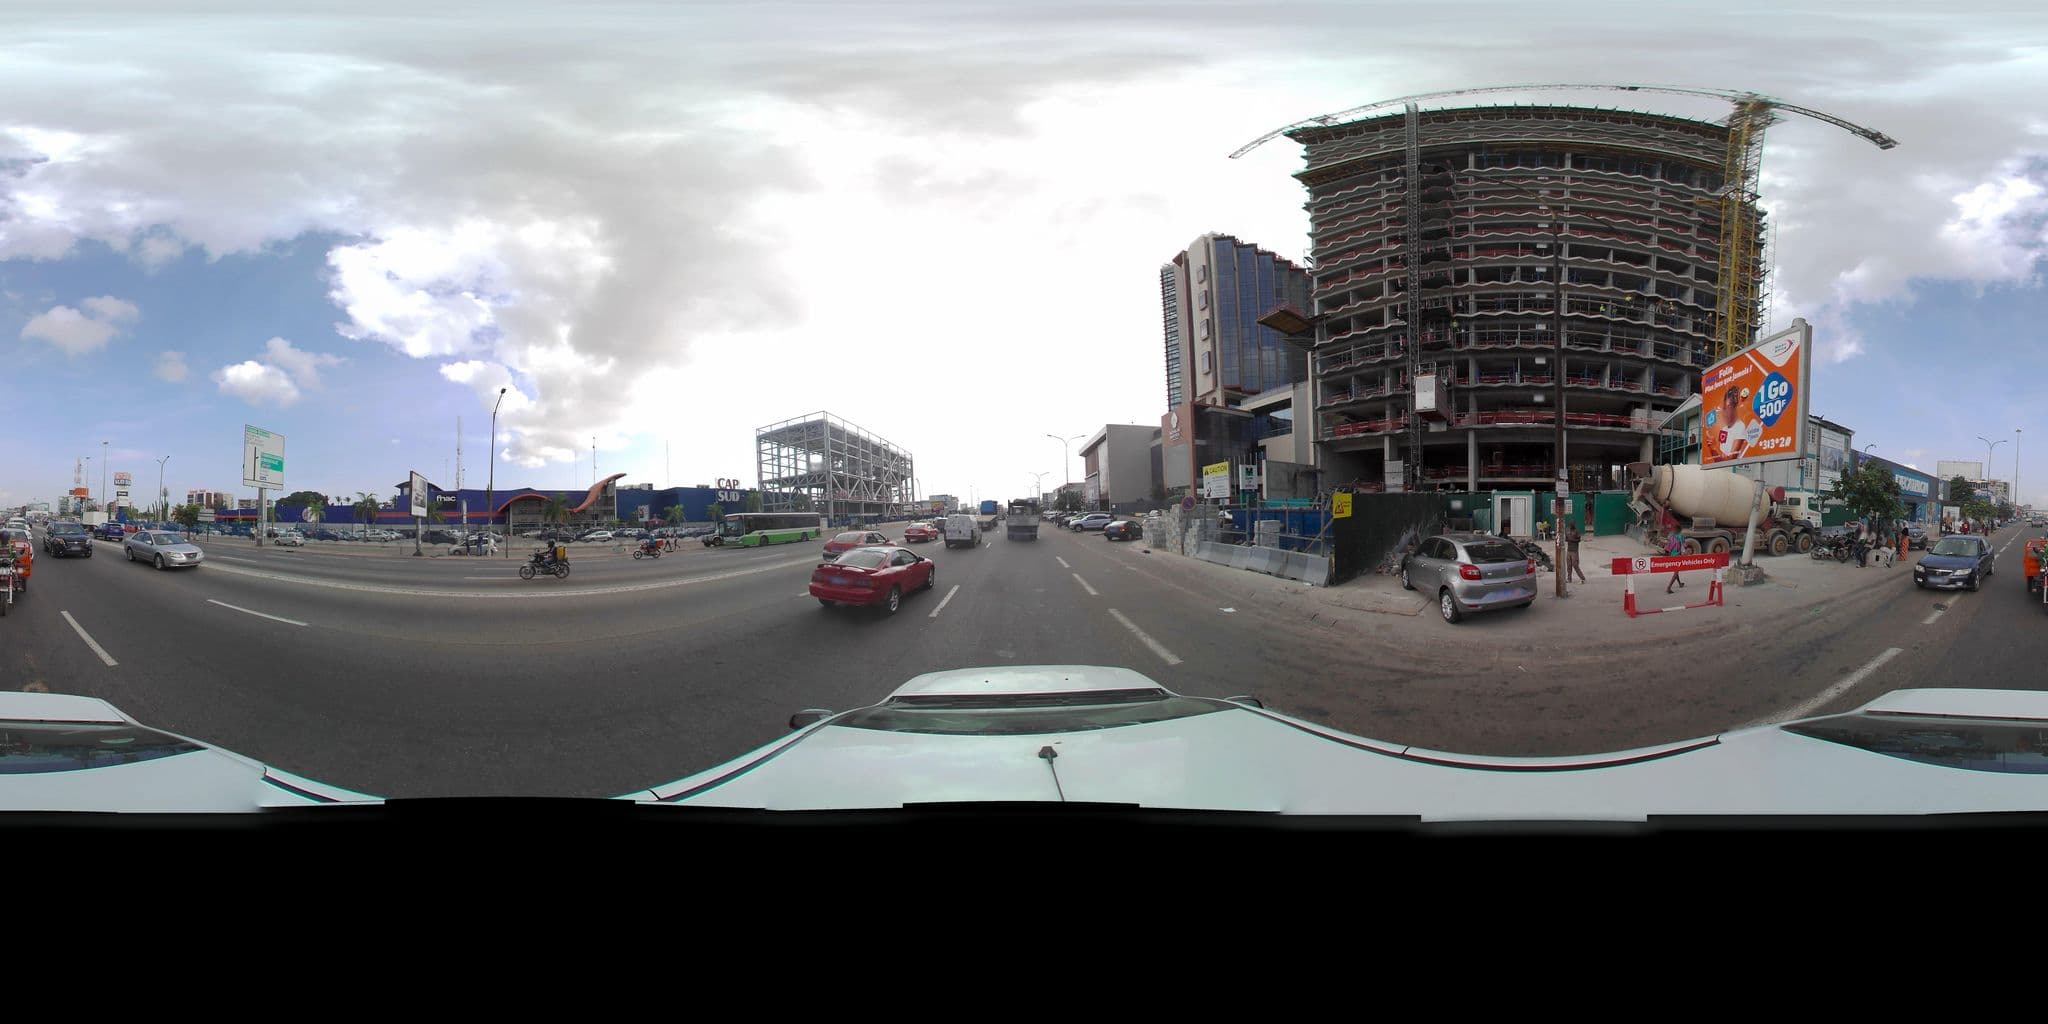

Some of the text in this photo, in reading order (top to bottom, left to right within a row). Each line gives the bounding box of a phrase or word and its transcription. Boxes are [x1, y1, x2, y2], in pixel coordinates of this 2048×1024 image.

[1759, 380, 1788, 403] 1 Go
[1210, 465, 1228, 474] CAUTION
[718, 477, 739, 490] CAP
[436, 494, 456, 502] fnac
[718, 490, 739, 502] SUD
[1651, 560, 1681, 569] Emergency
